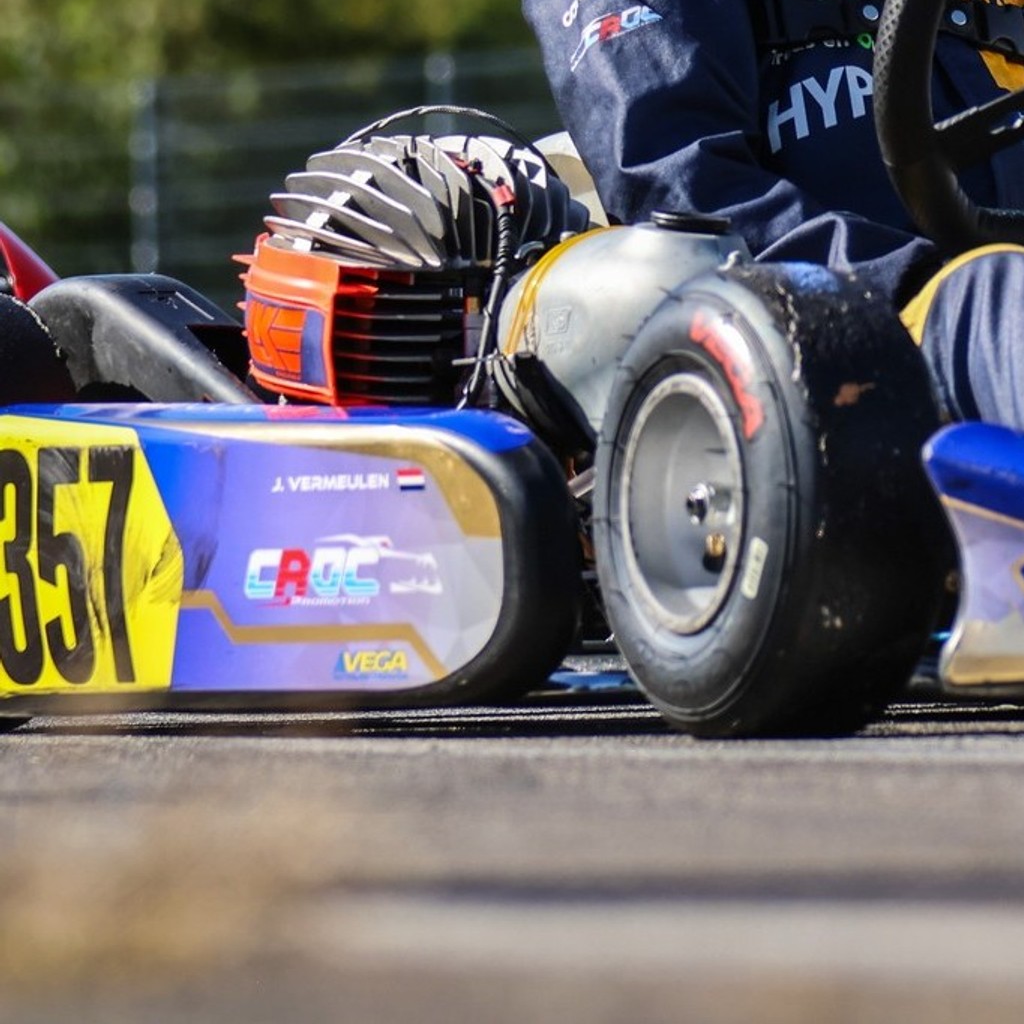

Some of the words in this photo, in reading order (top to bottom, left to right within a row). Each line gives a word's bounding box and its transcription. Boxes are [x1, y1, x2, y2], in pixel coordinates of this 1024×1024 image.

[767, 65, 876, 154] HYP
[288, 473, 390, 492] VERMEULEN
[0, 446, 137, 686] 357
[343, 650, 408, 673] VEGA
